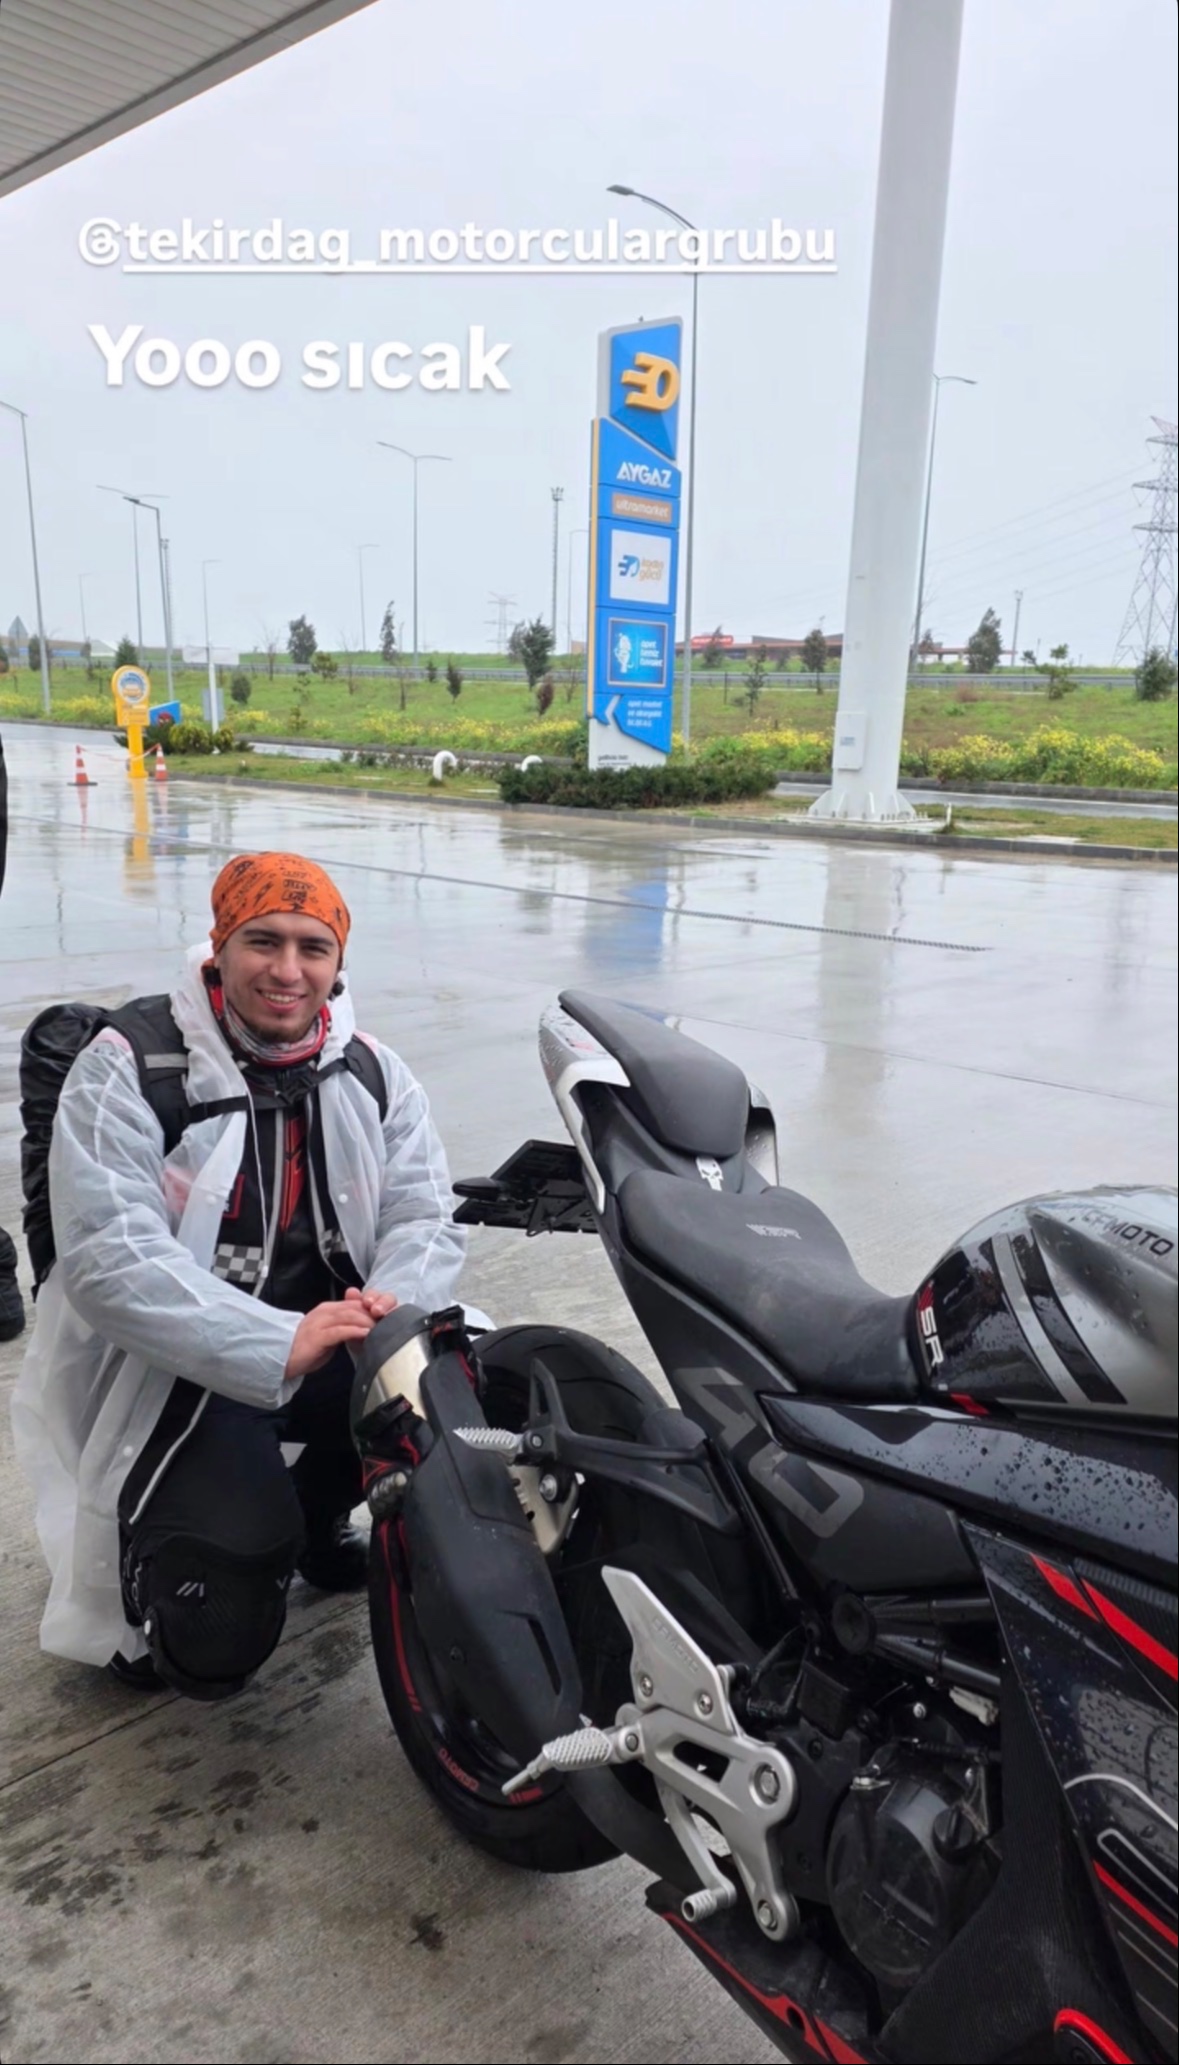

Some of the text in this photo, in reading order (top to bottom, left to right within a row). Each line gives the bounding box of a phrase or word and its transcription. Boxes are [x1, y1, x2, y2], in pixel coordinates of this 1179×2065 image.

[616, 461, 672, 488] AYGAZ
[1087, 1209, 1174, 1256] CFMOTO
[920, 1306, 944, 1368] SR
